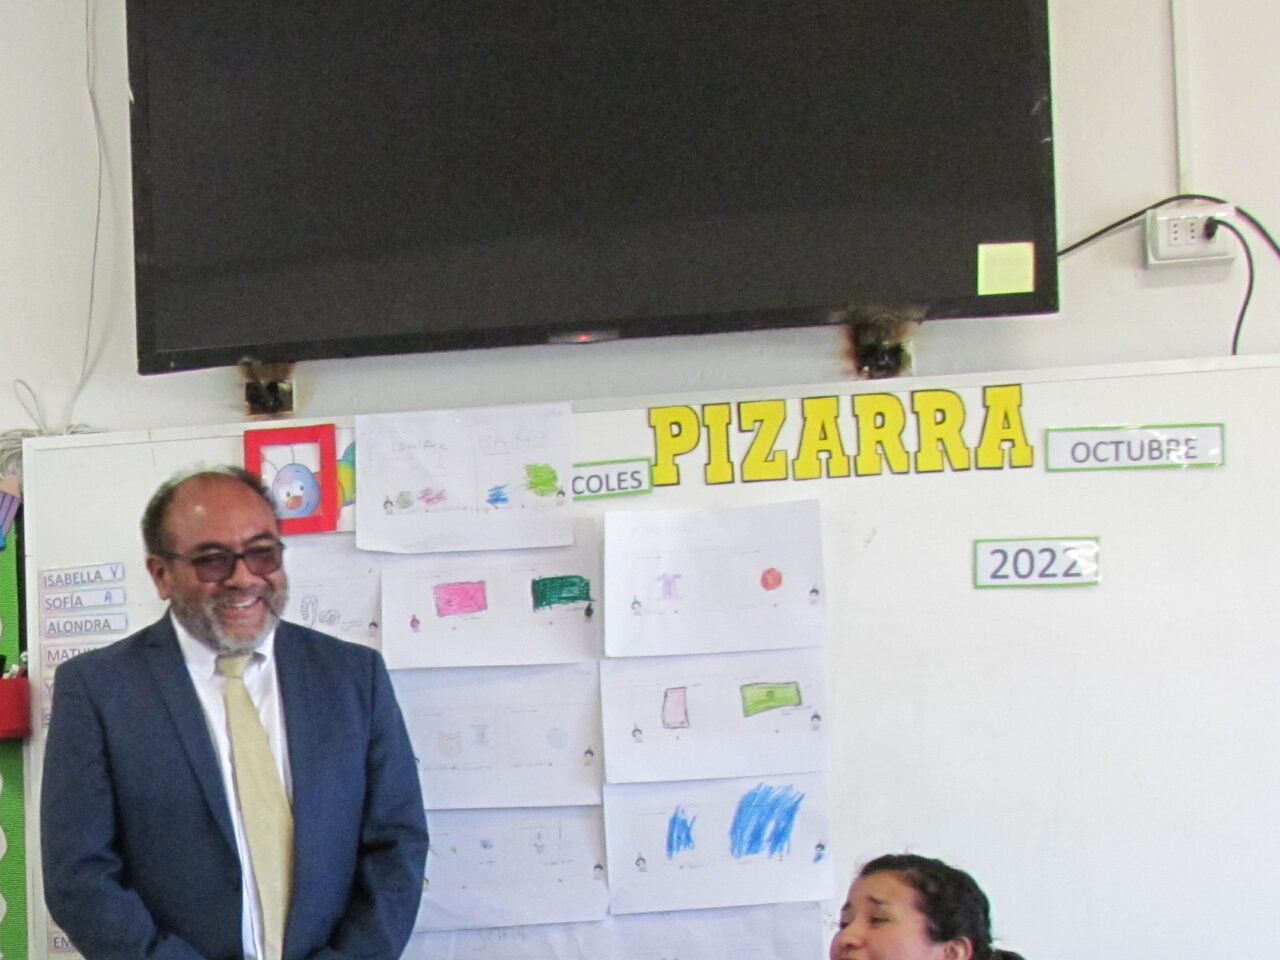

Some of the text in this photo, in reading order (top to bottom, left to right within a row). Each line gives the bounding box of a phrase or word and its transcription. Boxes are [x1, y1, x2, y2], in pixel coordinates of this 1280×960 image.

[648, 384, 1034, 487] PIZARRA
[1070, 438, 1199, 464] OCTUBRE
[571, 470, 642, 495] COLES
[989, 548, 1084, 580] 2022
[44, 570, 103, 588] ISABELLA
[45, 593, 83, 610] SOFÍA
[47, 618, 112, 634] ALONDRA
[47, 647, 92, 662] MAT
